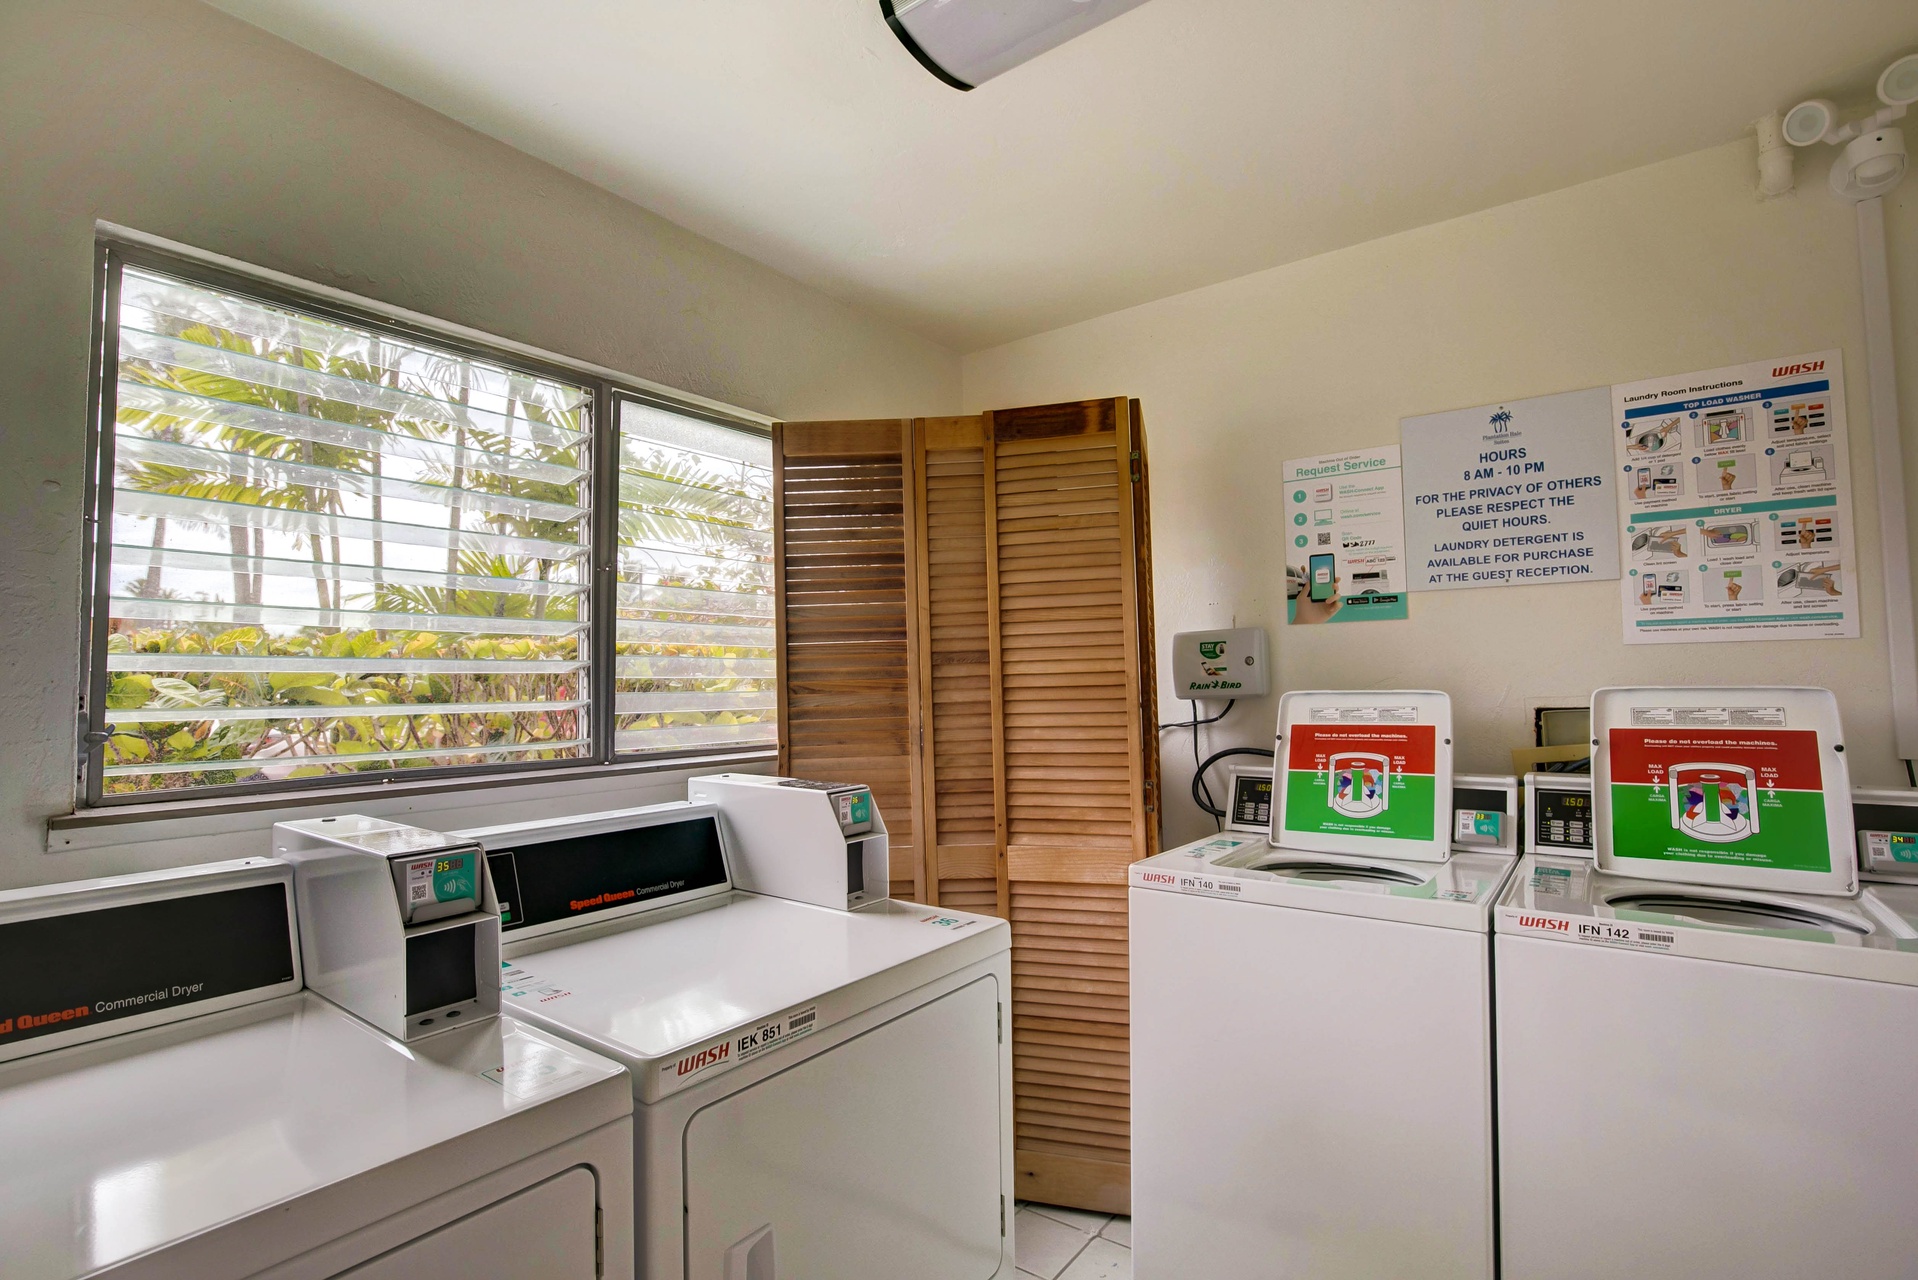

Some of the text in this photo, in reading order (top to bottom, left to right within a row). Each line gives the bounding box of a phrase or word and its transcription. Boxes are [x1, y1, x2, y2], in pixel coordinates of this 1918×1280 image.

[1772, 360, 1824, 377] WASH
[1624, 380, 1743, 402] Laundry Room Instructions
[1702, 398, 1723, 407] LOAD
[1726, 392, 1761, 402] WASHER
[1483, 432, 1508, 441] Plantation
[1480, 448, 1526, 463] HOURS
[1296, 457, 1386, 478] Request Service
[1464, 471, 1471, 481] 8
[1474, 468, 1494, 480] AM
[1507, 464, 1520, 476] 10
[1525, 461, 1544, 473] PM
[1416, 476, 1602, 505] FOR THE PRIVACY OF OTHERS
[1436, 495, 1575, 518] PLEASE RESPECT THE
[1462, 514, 1551, 532] QUIET HOURS.
[1434, 532, 1584, 552] LAUNDRY DETERGENT IS
[1428, 547, 1594, 568] AVAILABLE FOR PURCHASE
[1429, 564, 1593, 583] AT THE GUEST RECEPTION.
[411, 862, 433, 870] WASH
[437, 861, 449, 872] 35
[1143, 872, 1175, 884] WASH
[1181, 878, 1194, 887] IFN
[1198, 881, 1213, 889] 140
[570, 879, 685, 911] Speed Queen Commercial Dryer
[1519, 916, 1569, 931] WASH
[1579, 924, 1629, 939] IFN 142
[17, 1004, 90, 1030] Queen
[95, 988, 168, 1014] Commercial
[172, 982, 204, 1001] Dryer
[738, 1032, 758, 1052] IEK
[762, 1023, 780, 1042] 851
[678, 1041, 730, 1076] WASH
